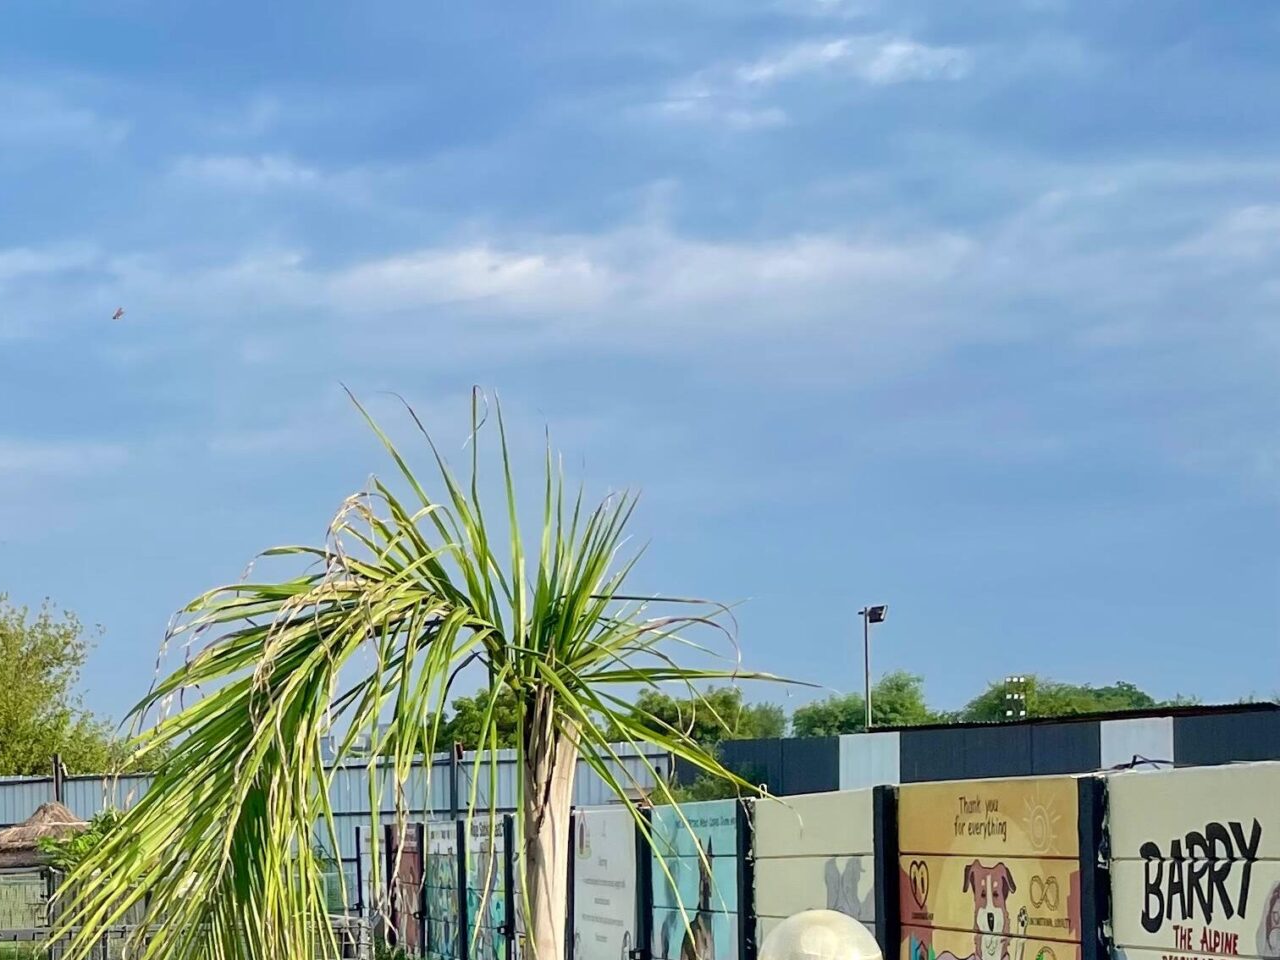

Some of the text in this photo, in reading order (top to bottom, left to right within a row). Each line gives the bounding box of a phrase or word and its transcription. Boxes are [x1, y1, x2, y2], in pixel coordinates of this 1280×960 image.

[959, 795, 999, 820] Thank you
[954, 814, 1007, 842] for everything
[1139, 817, 1263, 934] BARRY
[1172, 925, 1239, 955] THE ALPINE
